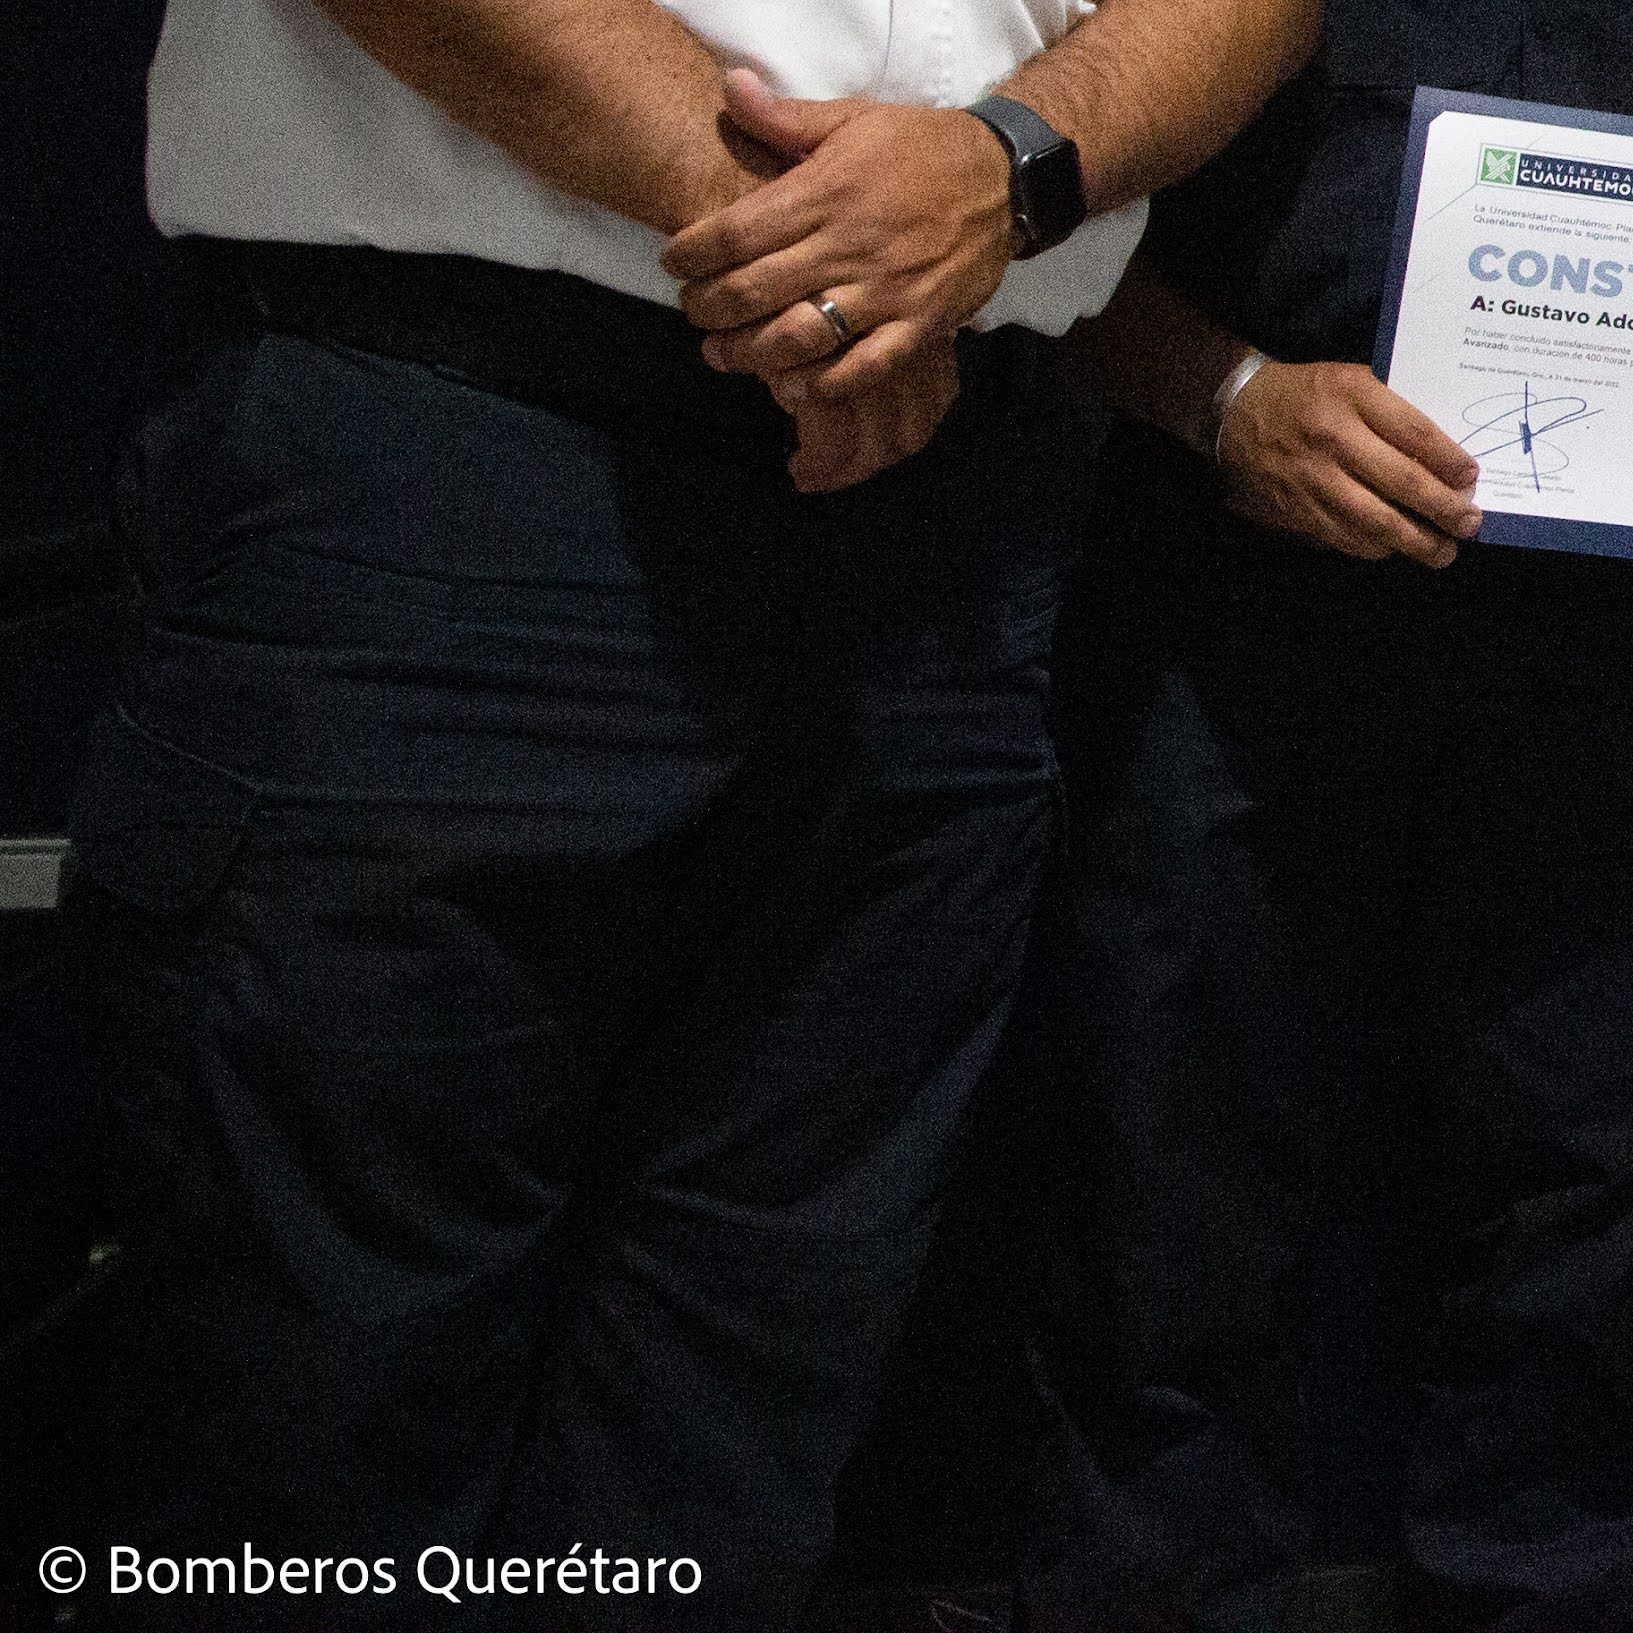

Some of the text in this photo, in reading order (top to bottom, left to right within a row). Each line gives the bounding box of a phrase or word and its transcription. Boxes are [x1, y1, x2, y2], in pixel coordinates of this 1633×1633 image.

[1472, 213, 1525, 230] Querétaro
[1527, 221, 1571, 236] extiende
[1488, 204, 1548, 222] Universidad
[1549, 213, 1612, 230] Cuauhtémoc
[1470, 295, 1494, 311] A:
[1501, 299, 1589, 323] Gustavo
[1584, 353, 1602, 362] 400
[1603, 355, 1627, 366] horas
